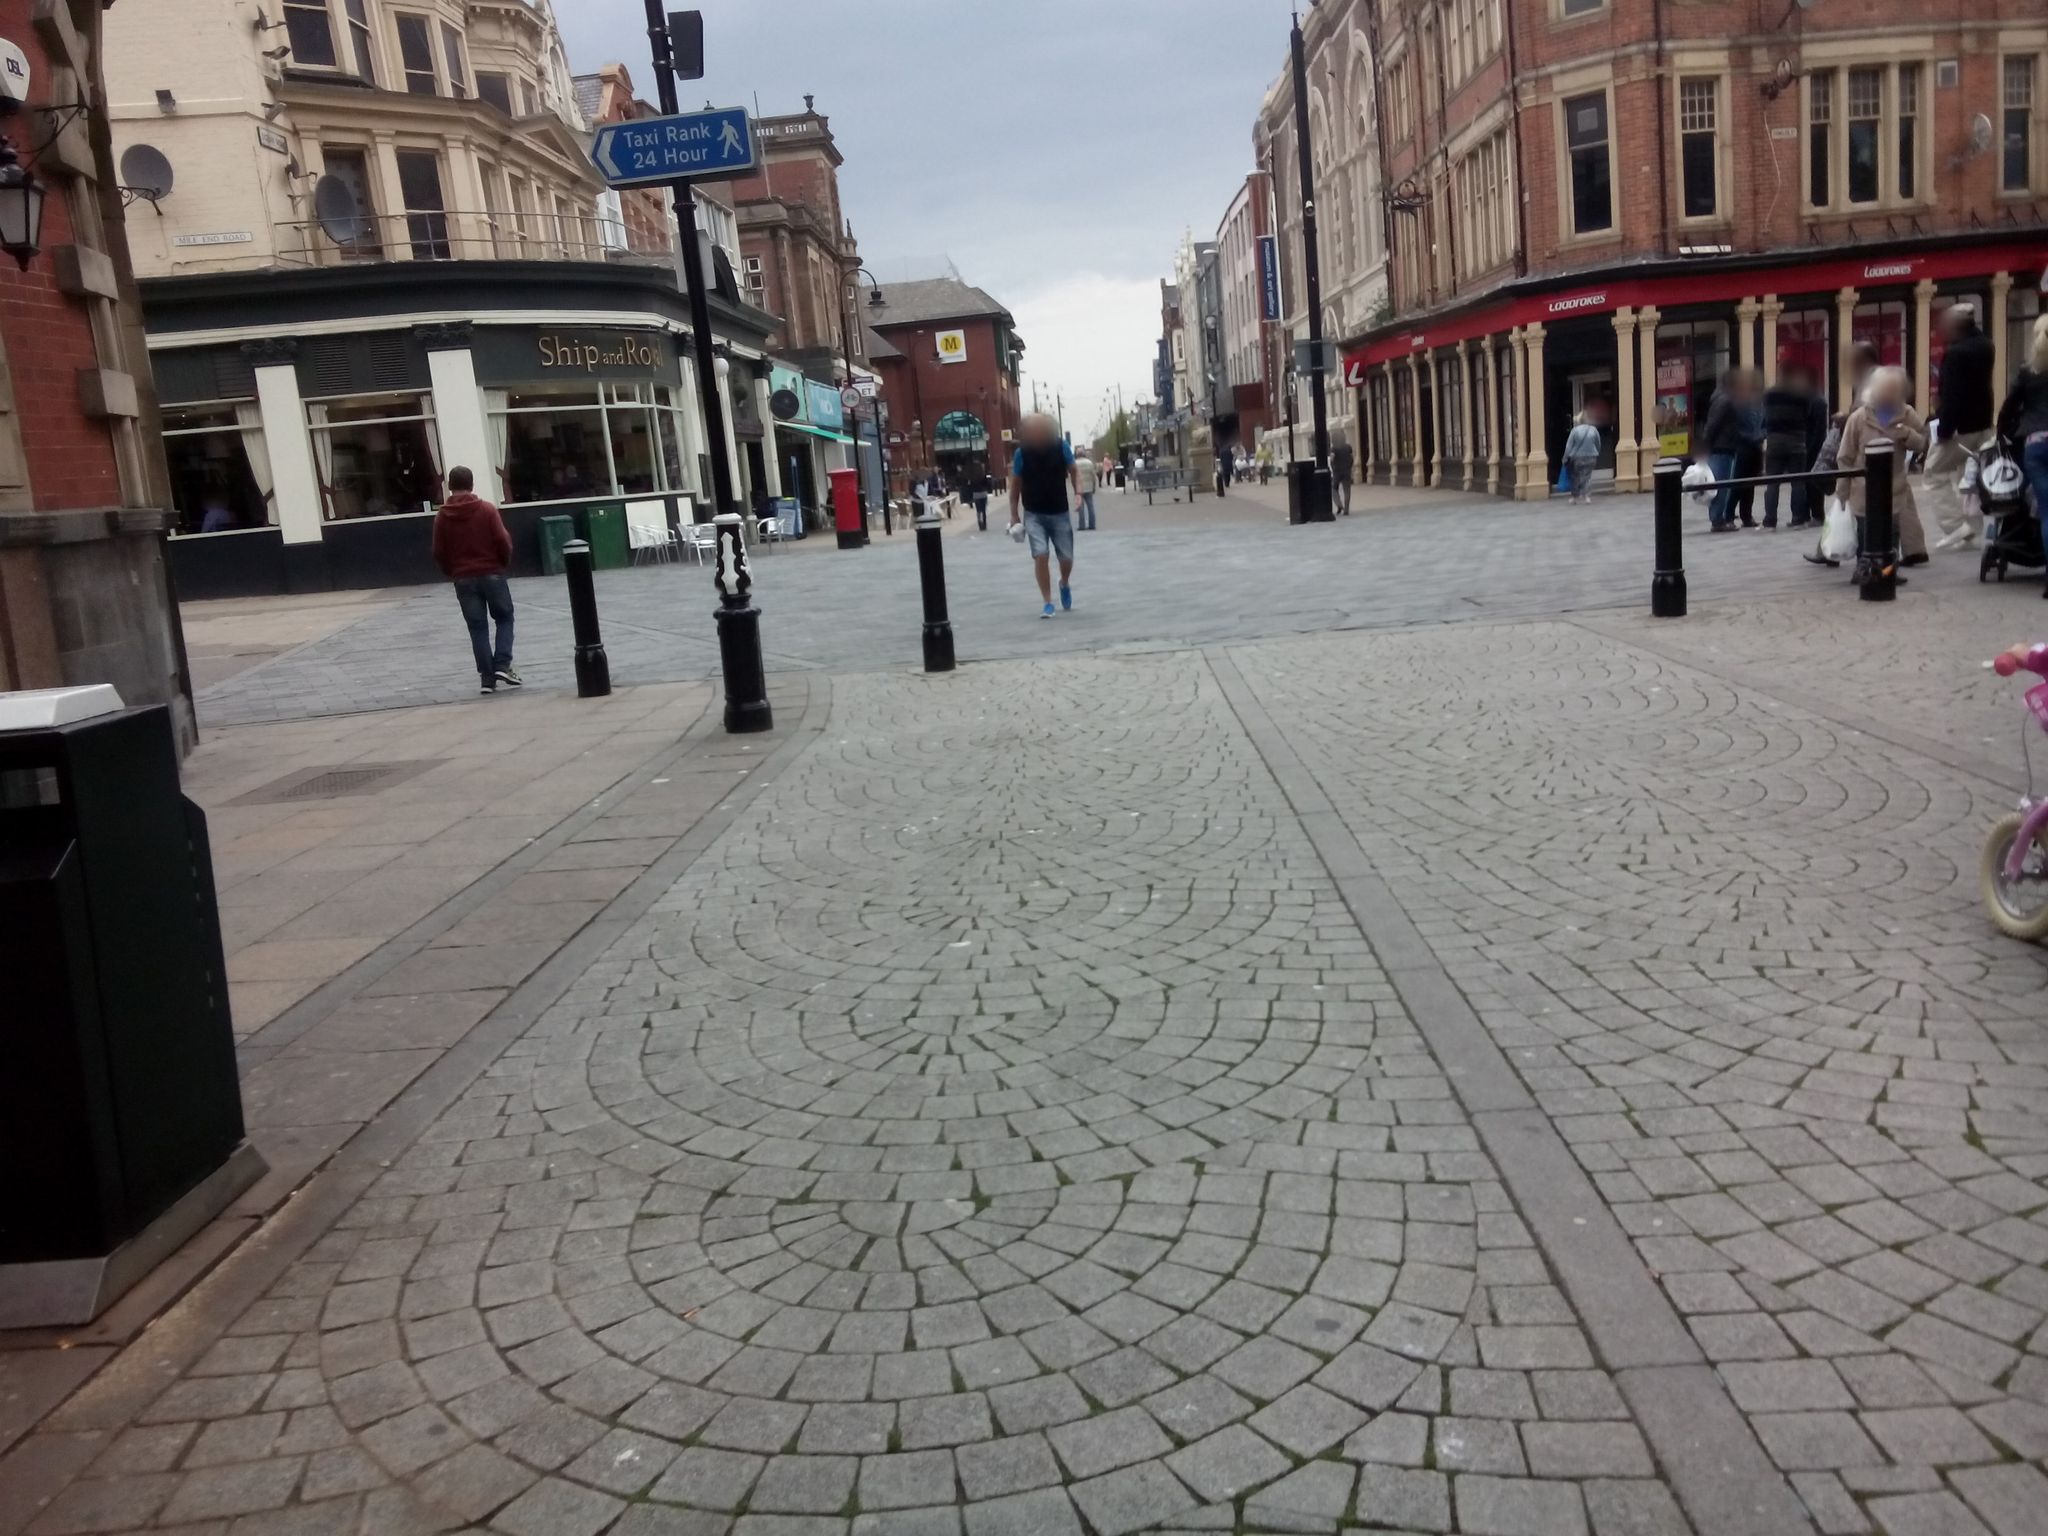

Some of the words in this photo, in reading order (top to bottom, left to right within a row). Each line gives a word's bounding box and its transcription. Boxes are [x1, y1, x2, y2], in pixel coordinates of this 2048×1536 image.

[624, 129, 659, 148] Taxi
[666, 123, 712, 143] Rank
[633, 151, 657, 169] 24
[665, 147, 708, 165] Hour
[202, 235, 219, 243] END
[223, 233, 247, 241] ROAD
[538, 336, 599, 373] Ship
[602, 347, 624, 366] and
[944, 336, 958, 351] M
